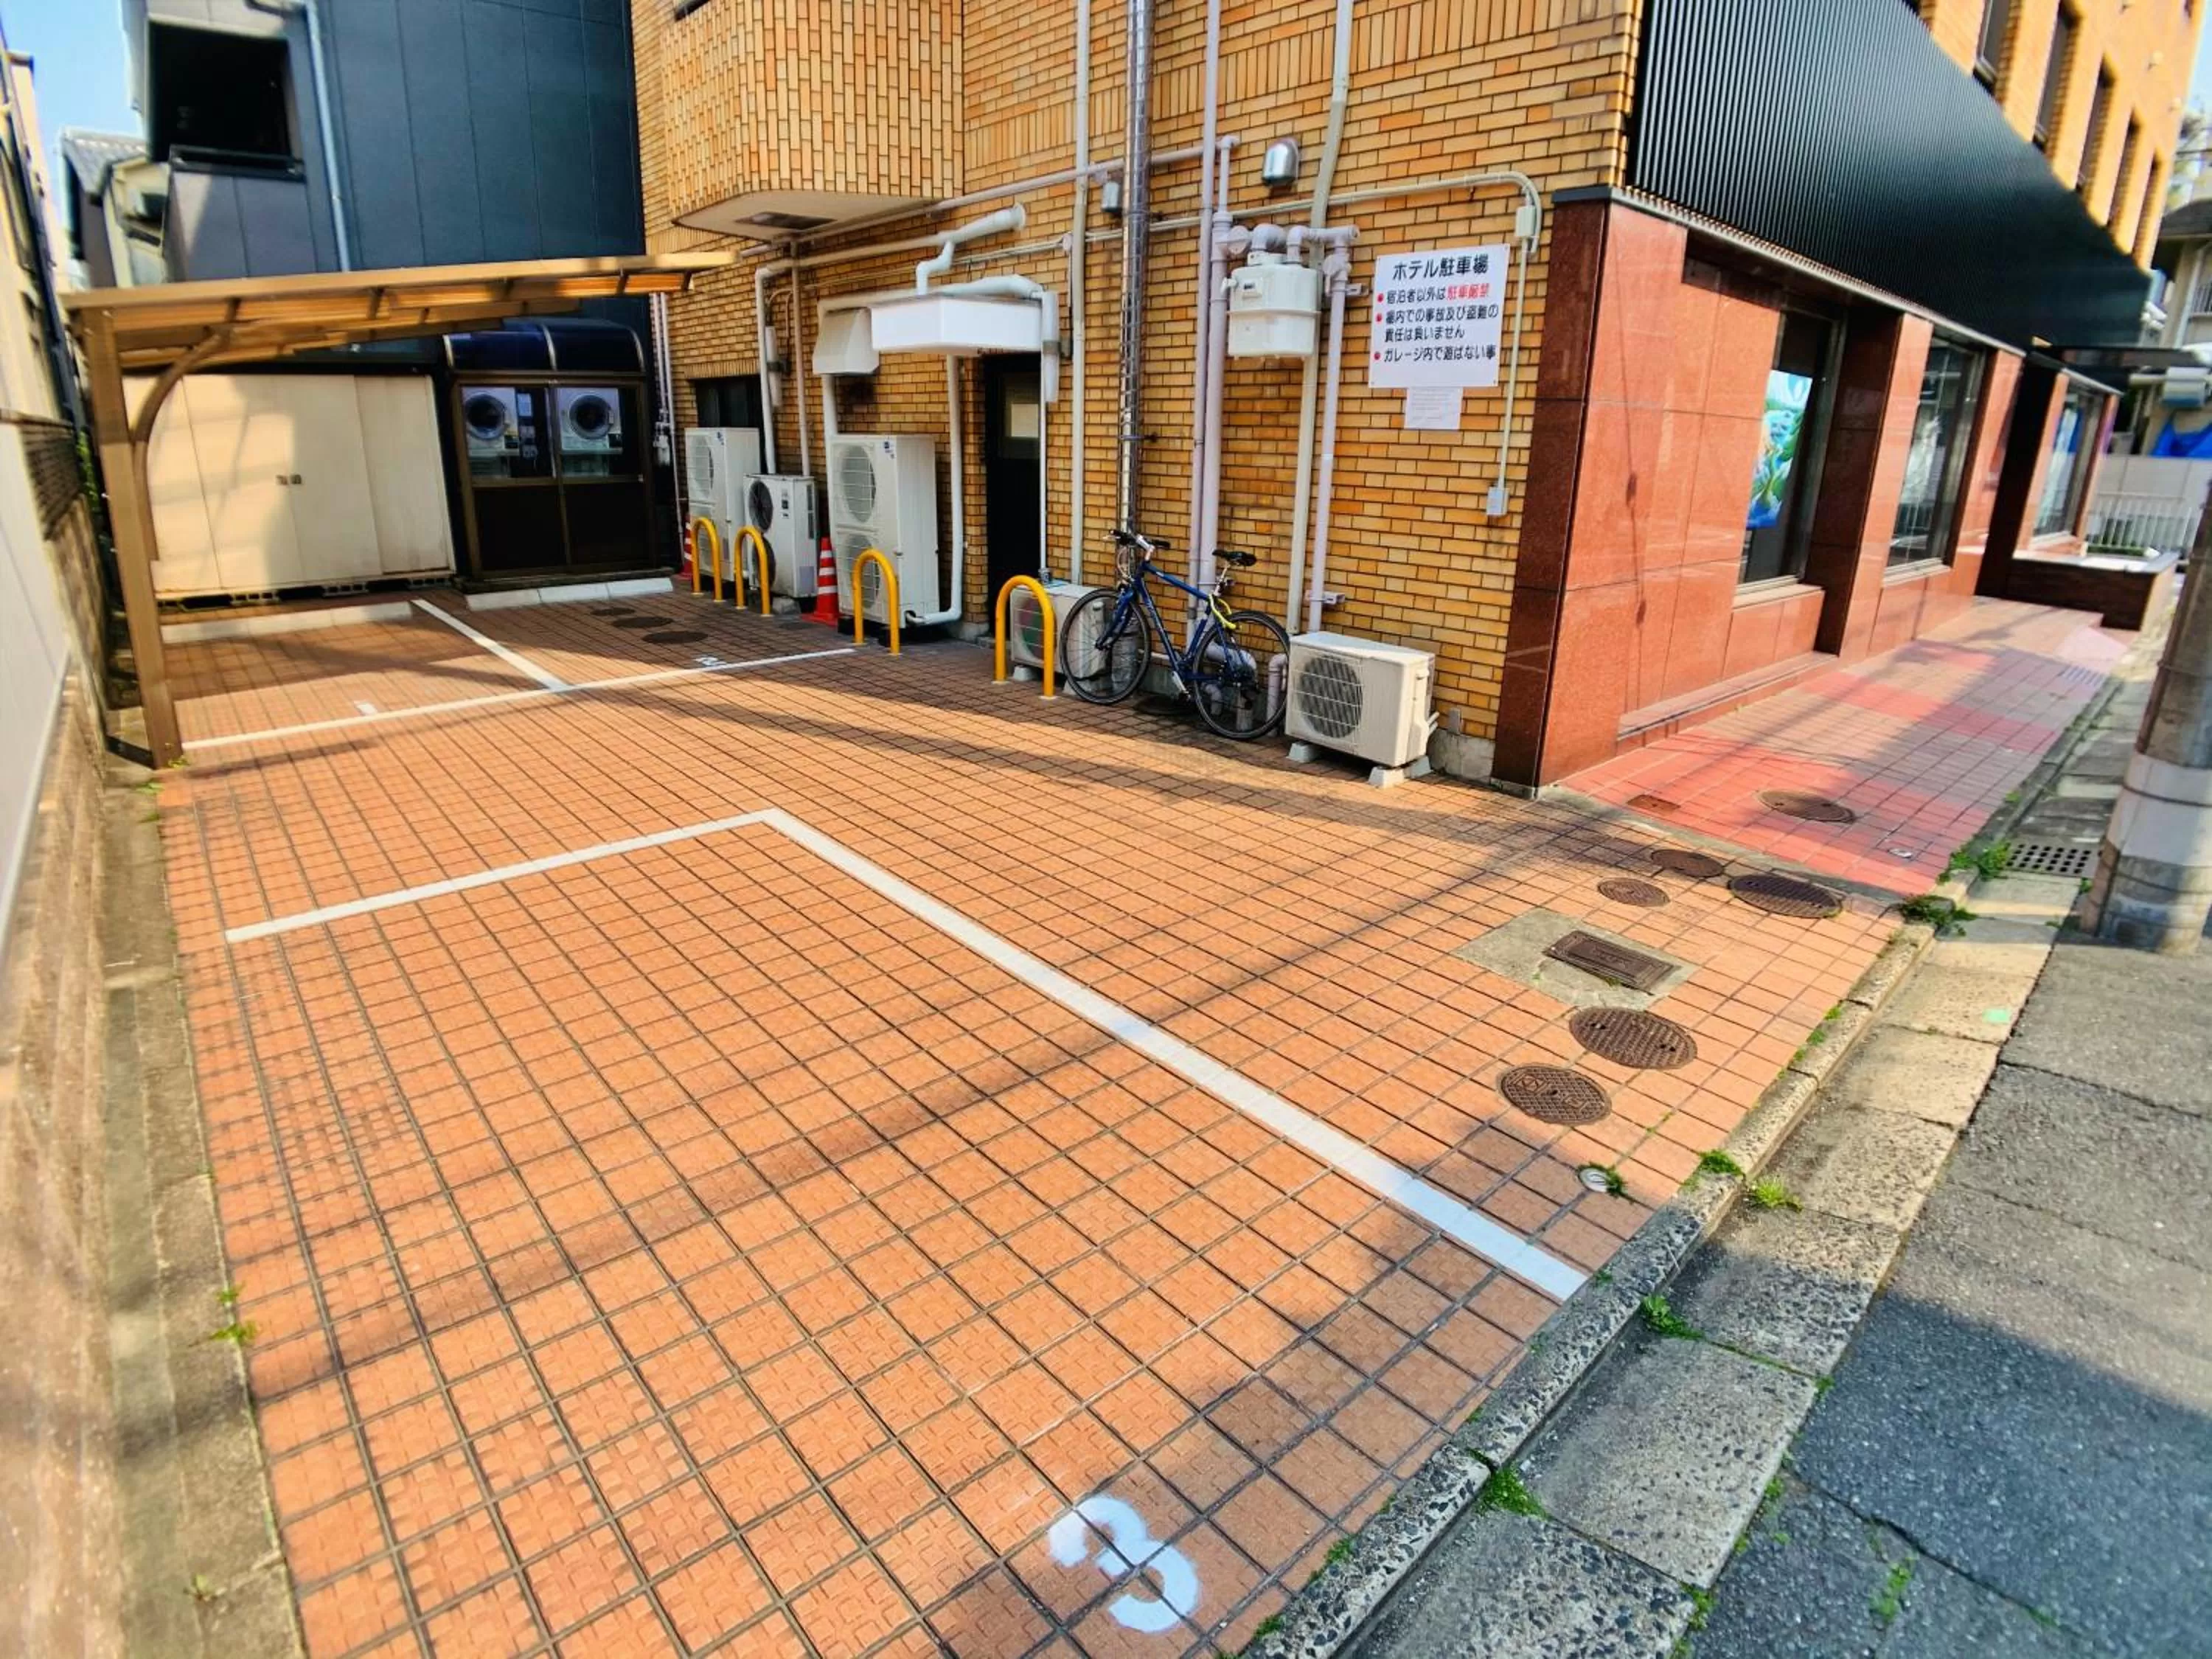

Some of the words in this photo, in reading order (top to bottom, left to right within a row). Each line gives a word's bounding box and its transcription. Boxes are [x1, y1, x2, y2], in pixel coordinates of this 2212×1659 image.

[1392, 254, 1489, 280] ホテル駐車場
[1385, 325, 1464, 343] 責任は負いません
[1384, 344, 1496, 362] ガレージ内で遊ばない事
[1048, 1494, 1199, 1633] 3
